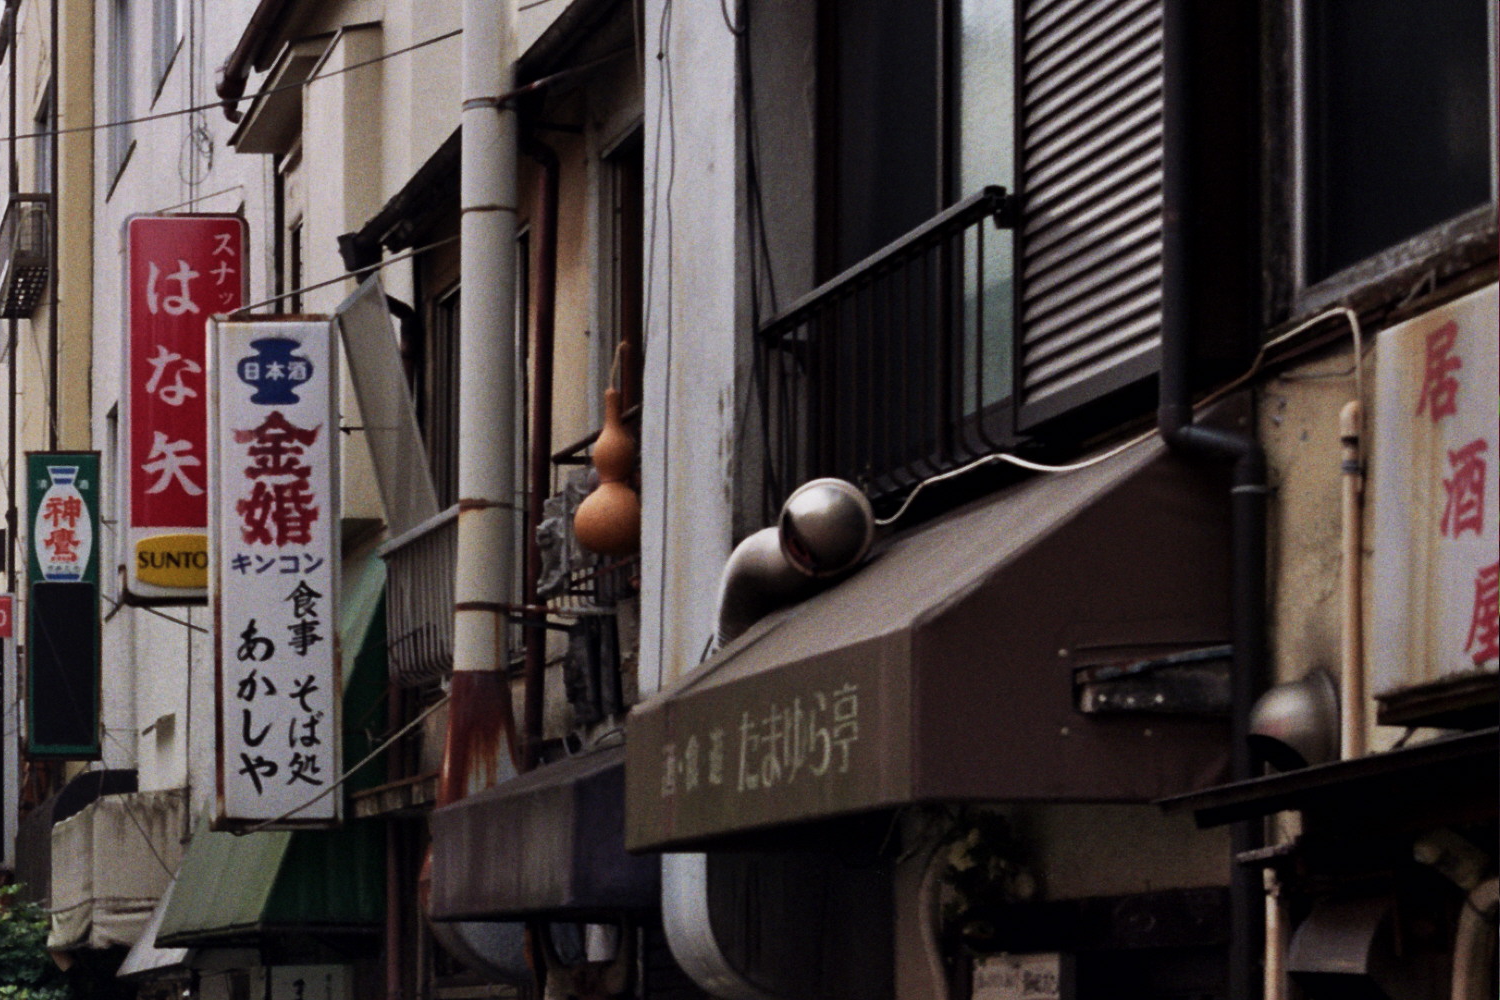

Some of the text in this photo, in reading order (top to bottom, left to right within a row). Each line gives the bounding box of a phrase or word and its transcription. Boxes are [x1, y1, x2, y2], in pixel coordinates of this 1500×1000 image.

[209, 232, 237, 306] スナッ
[141, 259, 205, 497] はな矢
[243, 360, 308, 381] 日本酒
[233, 409, 323, 548] 金婚
[1415, 319, 1500, 665] 居酒屋
[137, 551, 208, 570] SUNTO
[230, 552, 324, 576] キンコン
[237, 618, 279, 795] あかしや
[284, 580, 325, 786] 食事 そば処
